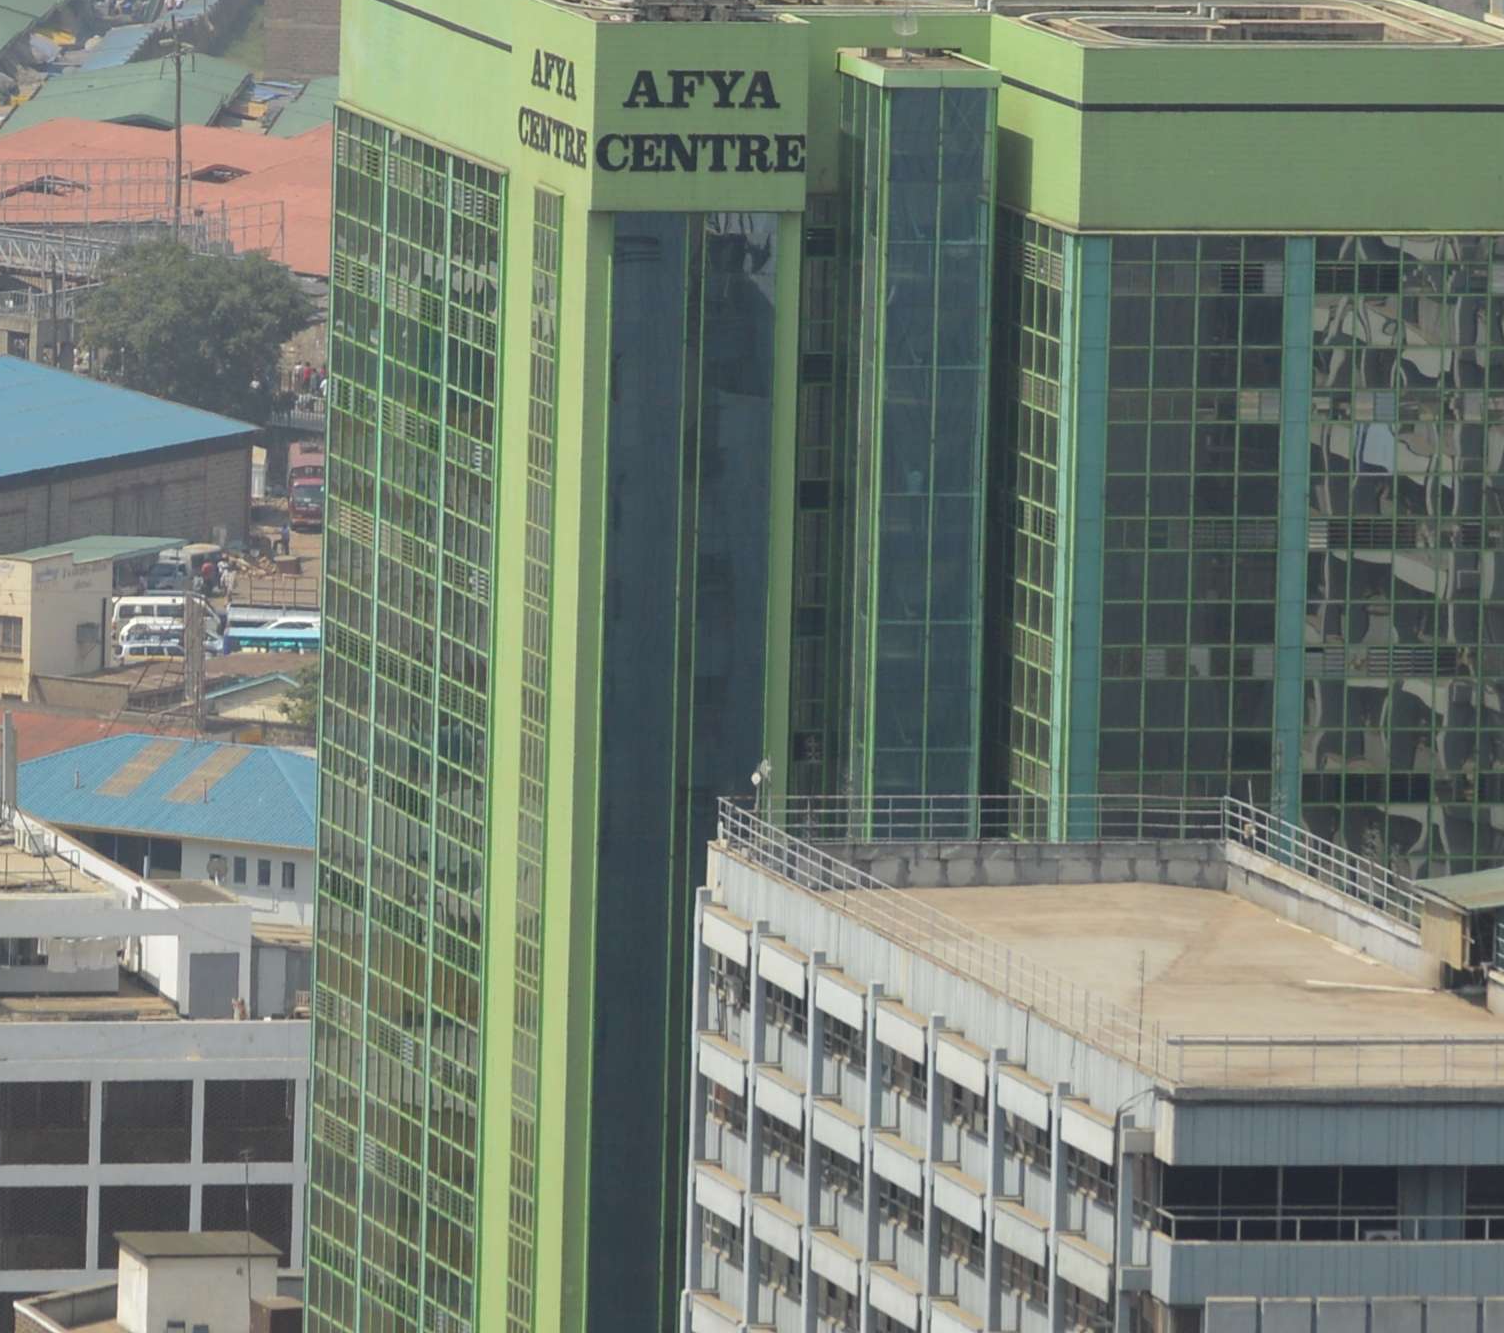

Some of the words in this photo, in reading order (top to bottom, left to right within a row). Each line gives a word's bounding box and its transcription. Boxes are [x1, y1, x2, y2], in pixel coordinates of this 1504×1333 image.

[531, 48, 577, 102] AFYA
[623, 69, 781, 109] AFYA
[518, 106, 587, 169] CENTRE
[595, 133, 807, 173] CENTRE
